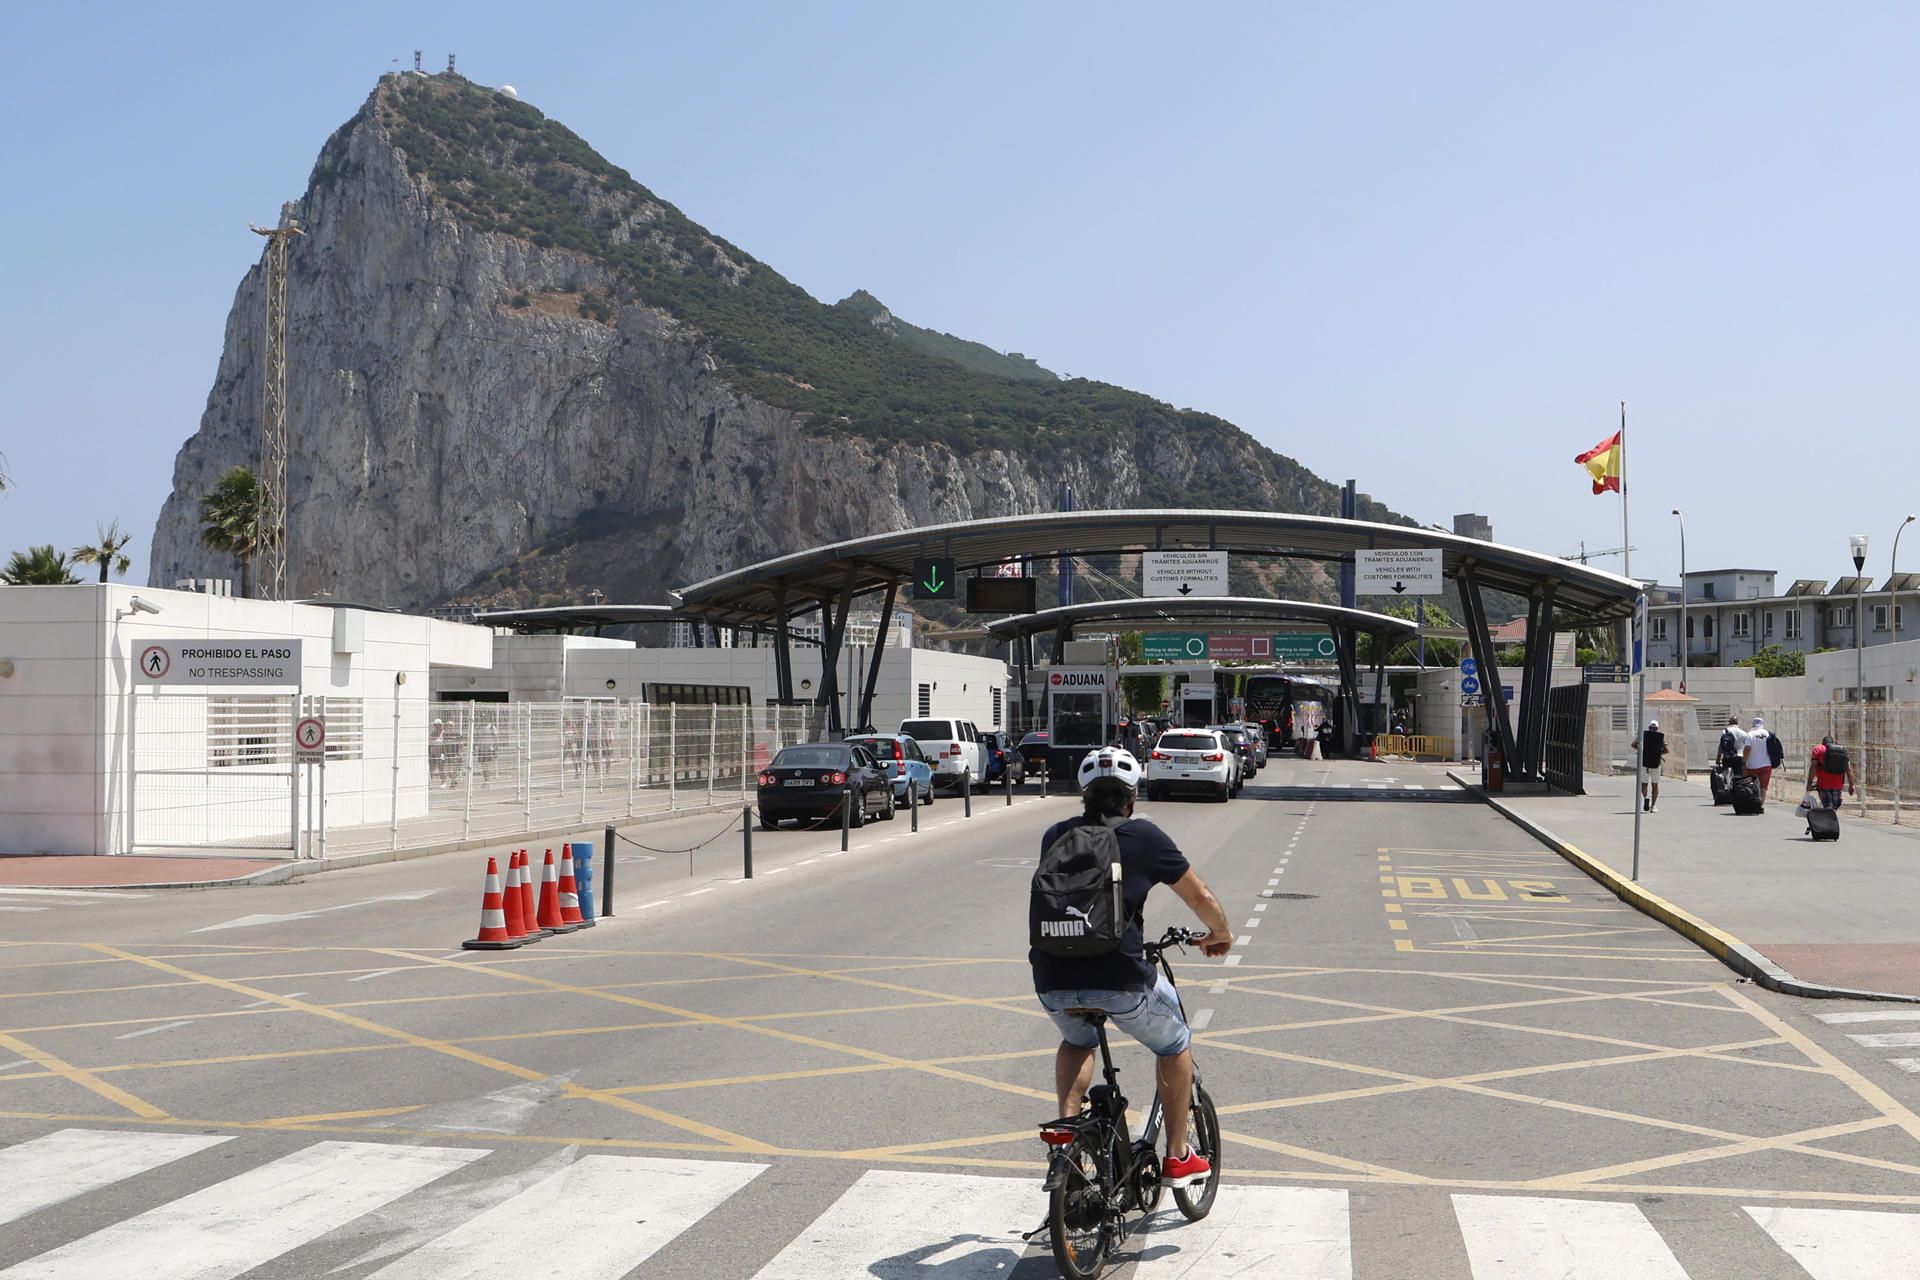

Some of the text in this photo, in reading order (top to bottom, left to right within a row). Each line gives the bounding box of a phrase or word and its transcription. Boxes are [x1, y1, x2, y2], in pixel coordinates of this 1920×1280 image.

[182, 649, 291, 658] PROHIBIDO EL PASO
[189, 668, 283, 678] NO TRESPASSING
[1062, 674, 1105, 686] ADUANA
[1397, 876, 1571, 903] BUS
[1041, 920, 1085, 937] PUMA
